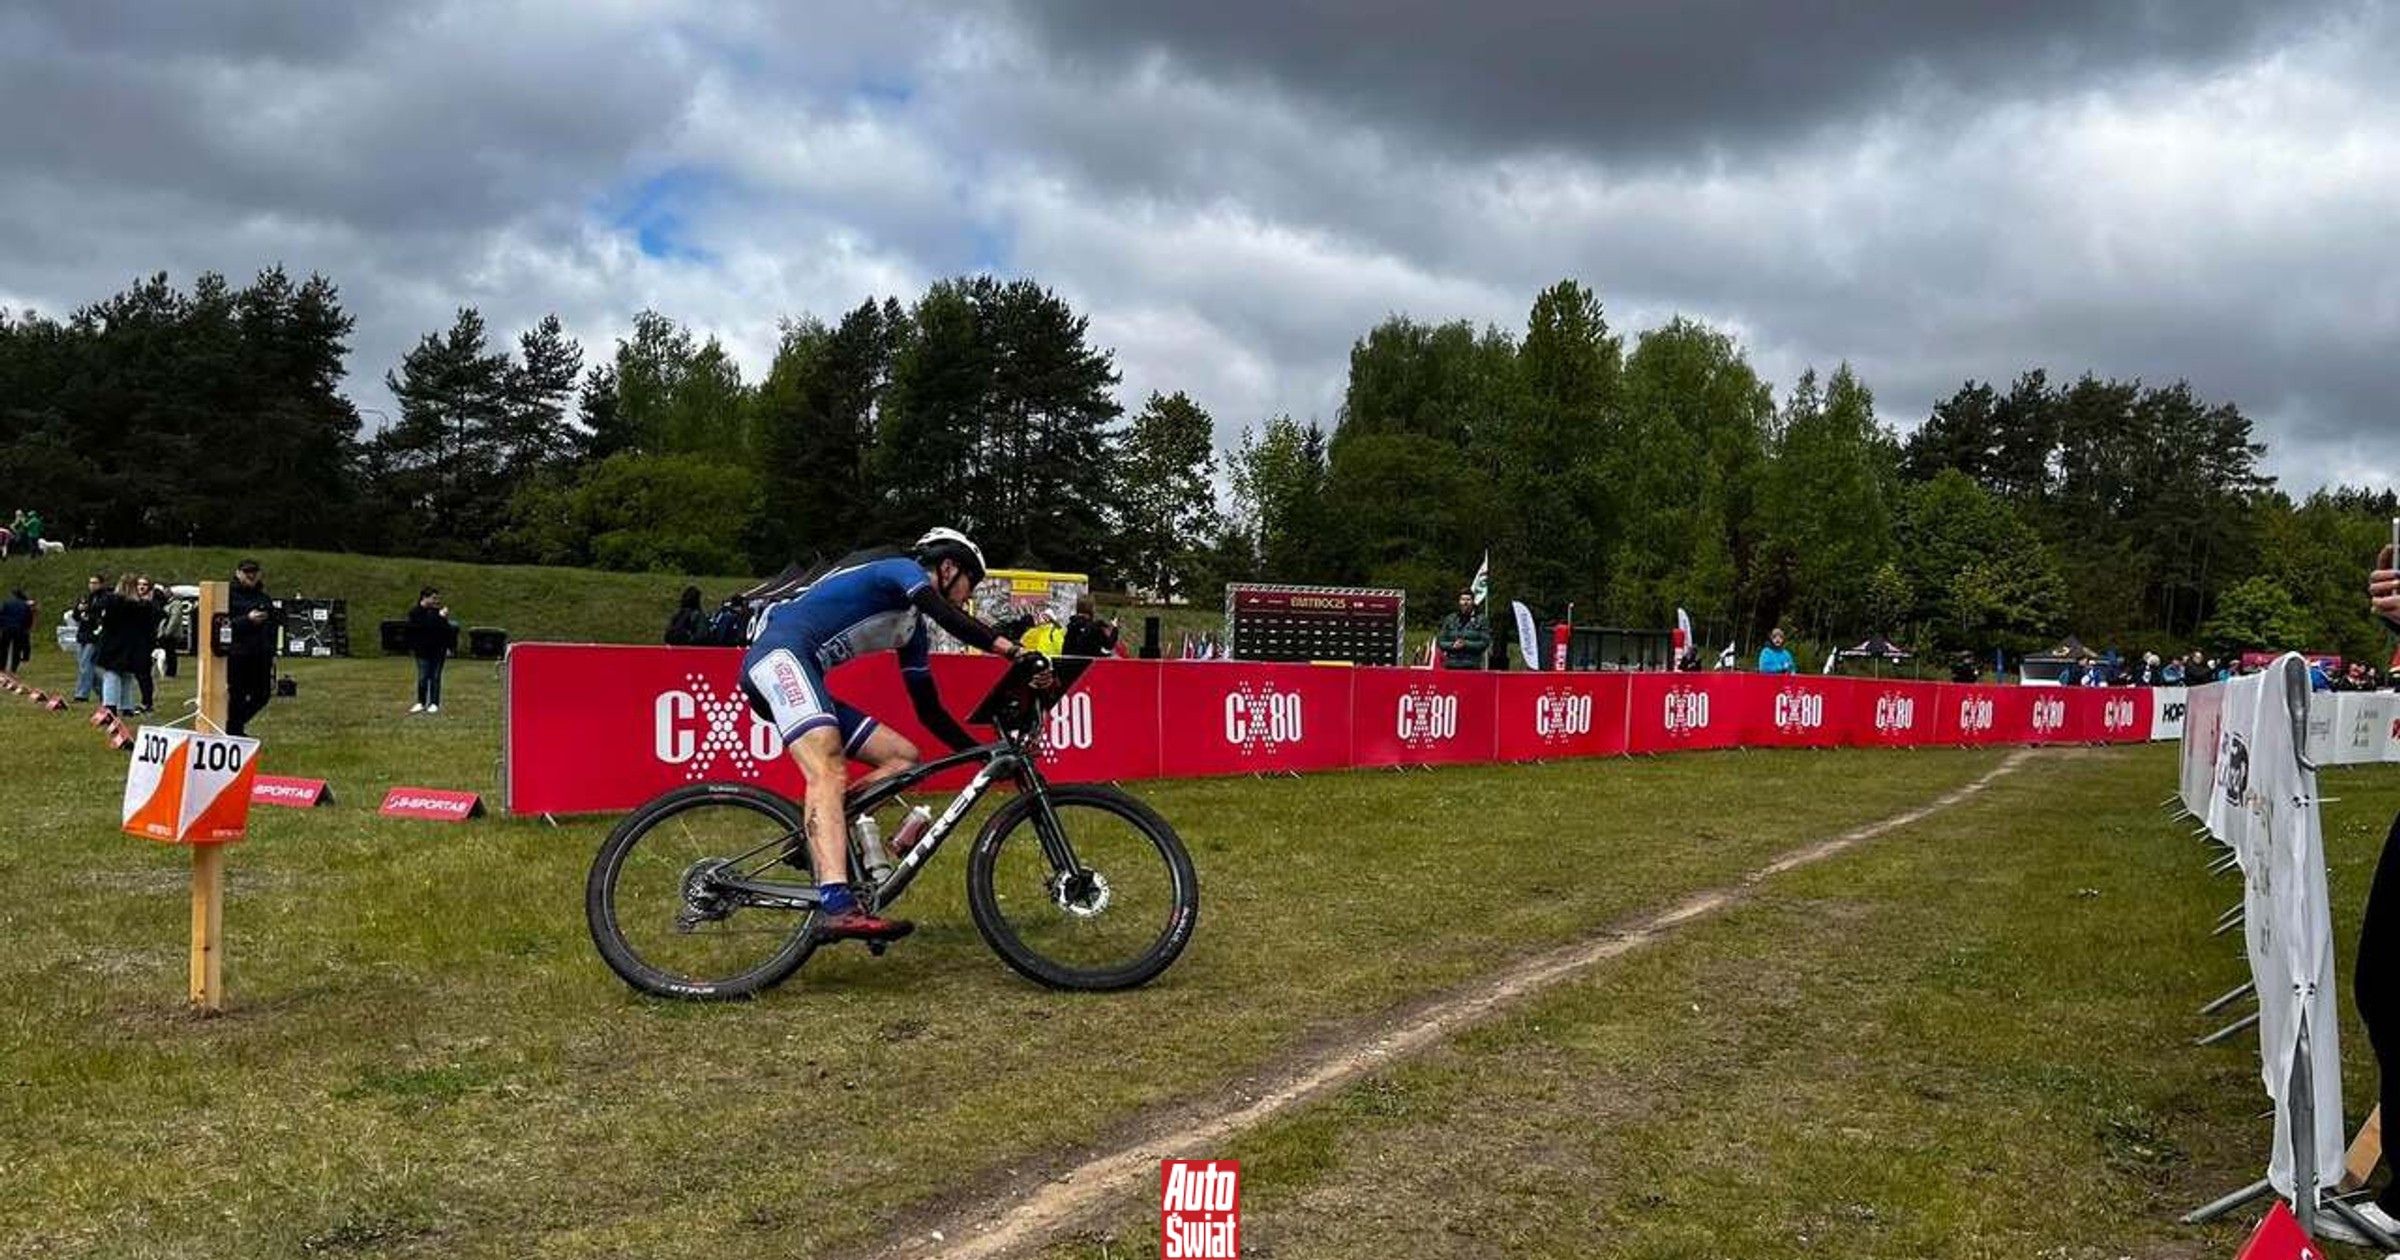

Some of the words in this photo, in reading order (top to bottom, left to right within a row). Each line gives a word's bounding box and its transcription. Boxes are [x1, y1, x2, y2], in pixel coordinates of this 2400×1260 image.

[655, 673, 783, 780] CX8
[1225, 680, 1302, 756] CX80
[1397, 684, 1457, 749] CX80
[1535, 686, 1591, 744] CX80
[1664, 684, 1709, 737] CX80
[1774, 686, 1822, 734] CX80
[1875, 691, 1914, 736] CX80
[1960, 694, 1993, 735] CX80
[193, 740, 241, 773] 100
[903, 769, 992, 868] TREK
